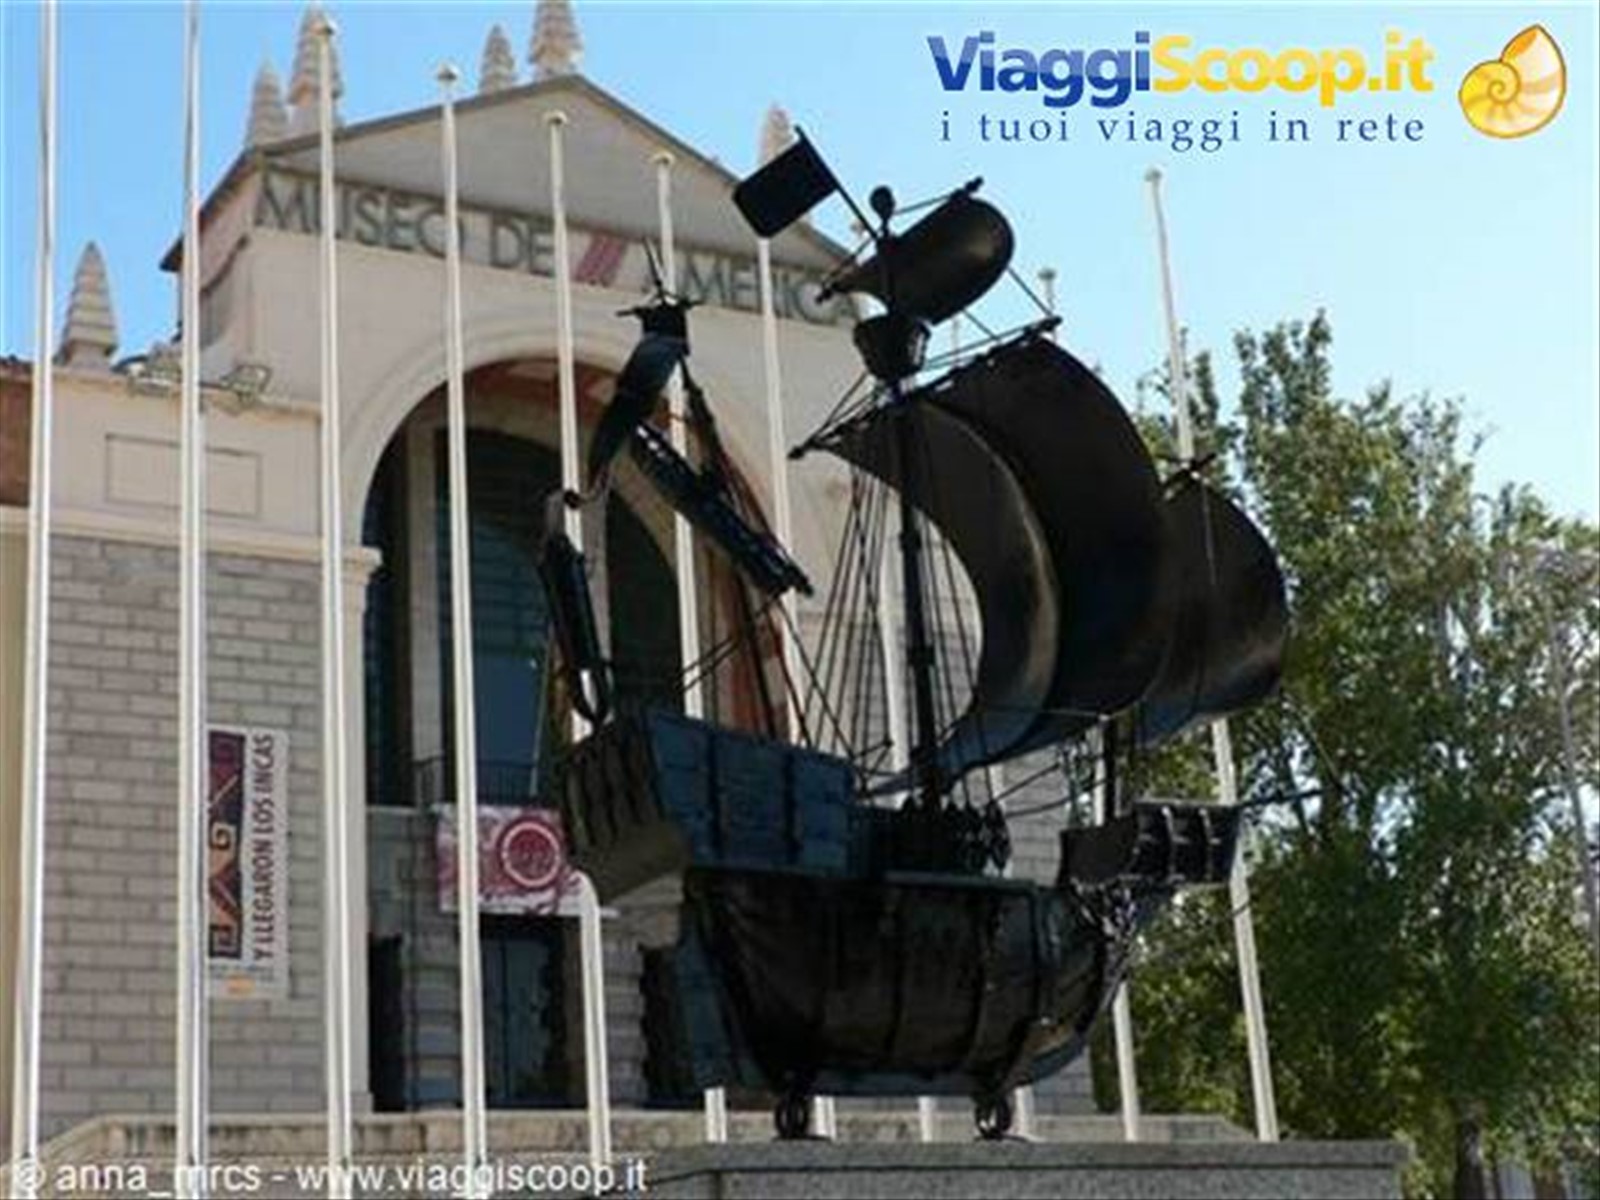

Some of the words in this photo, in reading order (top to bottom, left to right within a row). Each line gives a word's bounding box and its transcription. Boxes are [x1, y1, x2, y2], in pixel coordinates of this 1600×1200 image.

[254, 172, 465, 260] MUSEO
[489, 213, 557, 278] DE
[641, 235, 866, 330] MERICA
[252, 733, 275, 794] INCAS
[252, 799, 275, 836] LOS
[252, 840, 275, 945] LLEGARON
[252, 948, 274, 960] Y
